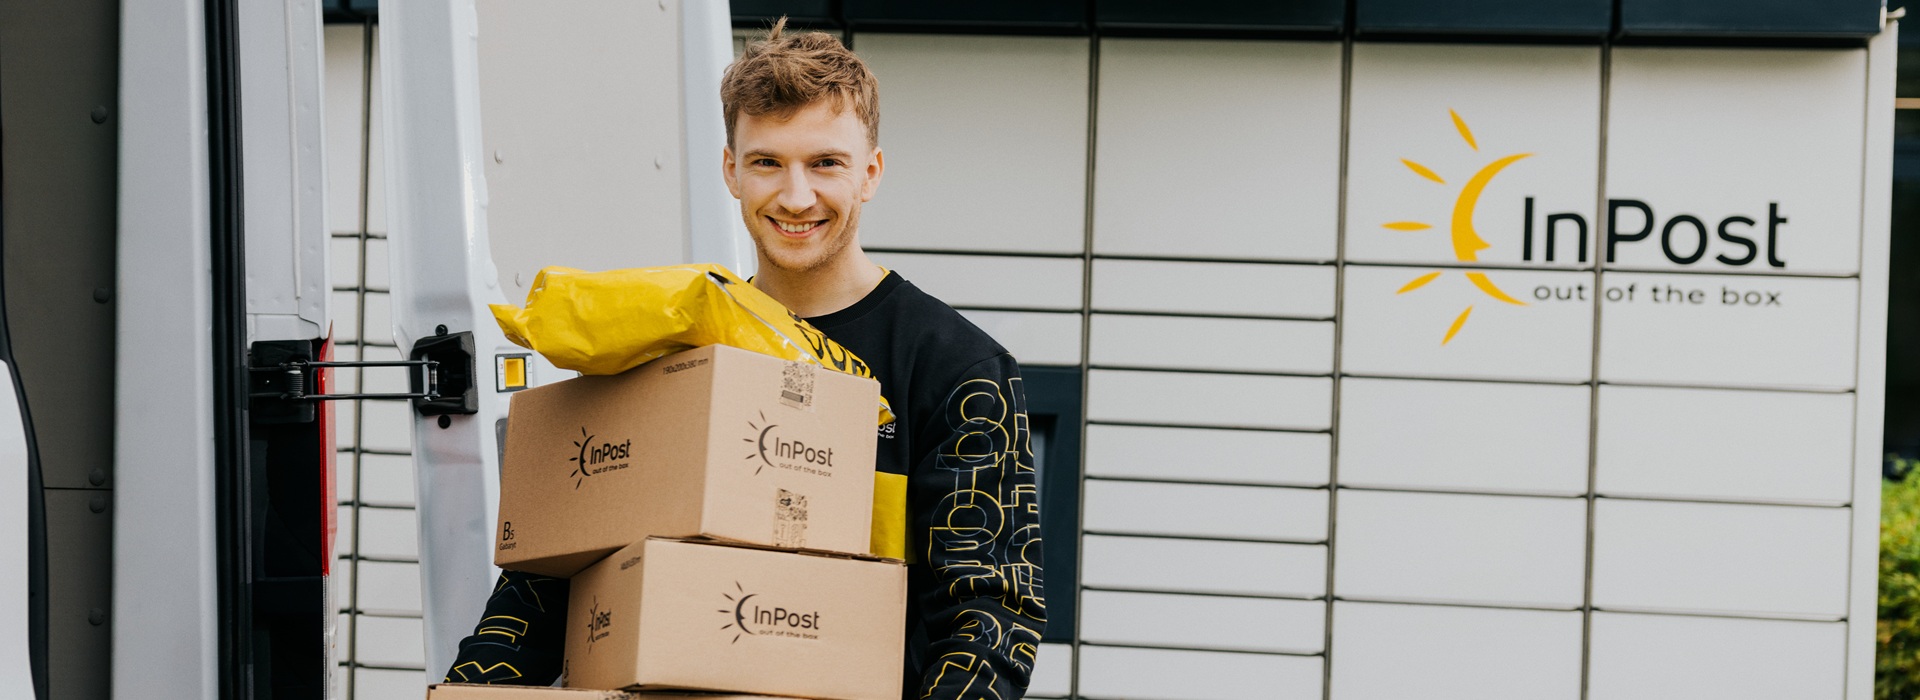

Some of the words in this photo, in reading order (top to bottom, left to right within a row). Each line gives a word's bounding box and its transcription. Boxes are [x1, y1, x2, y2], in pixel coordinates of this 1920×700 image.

[1522, 196, 1788, 268] InPost
[1533, 283, 1588, 301] out
[1606, 282, 1636, 302] of
[1651, 285, 1705, 304] the
[1721, 286, 1782, 306] box
[590, 438, 631, 465] InPost
[775, 436, 833, 467] InPost
[779, 462, 793, 470] out
[793, 464, 802, 472] of
[803, 466, 817, 475] the
[817, 469, 832, 478] box
[754, 605, 820, 631] InPost
